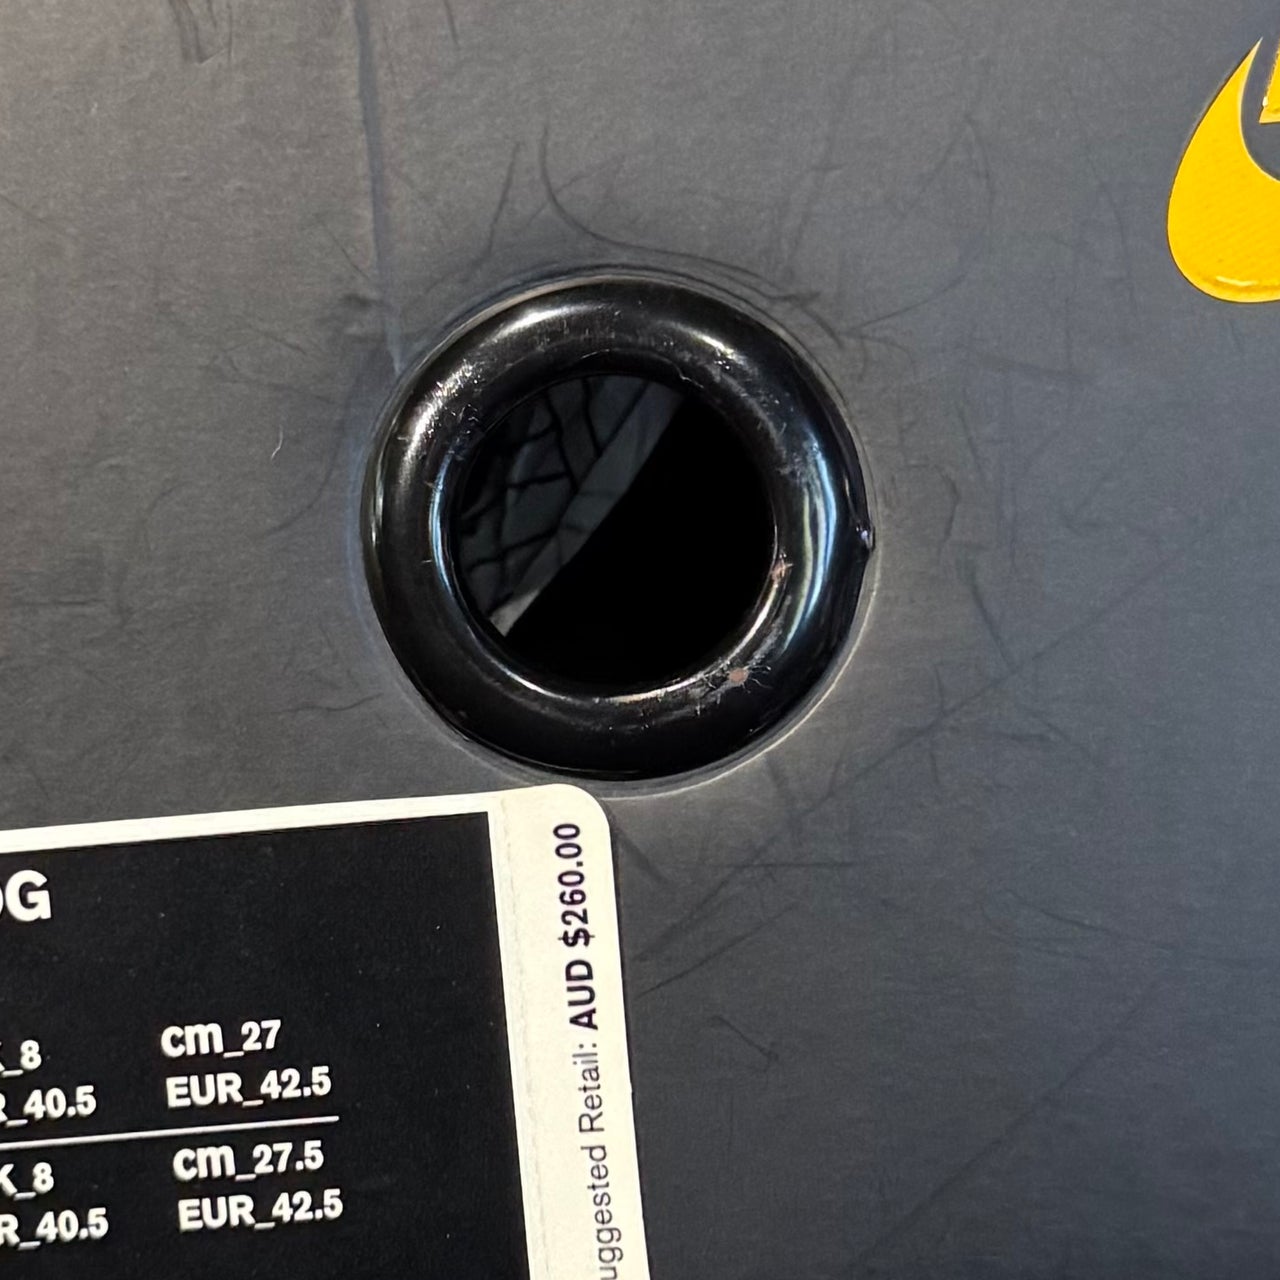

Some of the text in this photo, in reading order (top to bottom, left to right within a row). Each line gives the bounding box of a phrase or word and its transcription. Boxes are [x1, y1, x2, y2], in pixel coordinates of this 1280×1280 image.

[553, 822, 596, 948] $260.00
[565, 958, 600, 1030] AUD
[160, 1019, 282, 1059] cm_27
[166, 1065, 332, 1108] EUR_42.5
[572, 1041, 606, 1134] Retail:
[172, 1140, 324, 1182] cm_27.5
[177, 1188, 343, 1233] EUR_42.5
